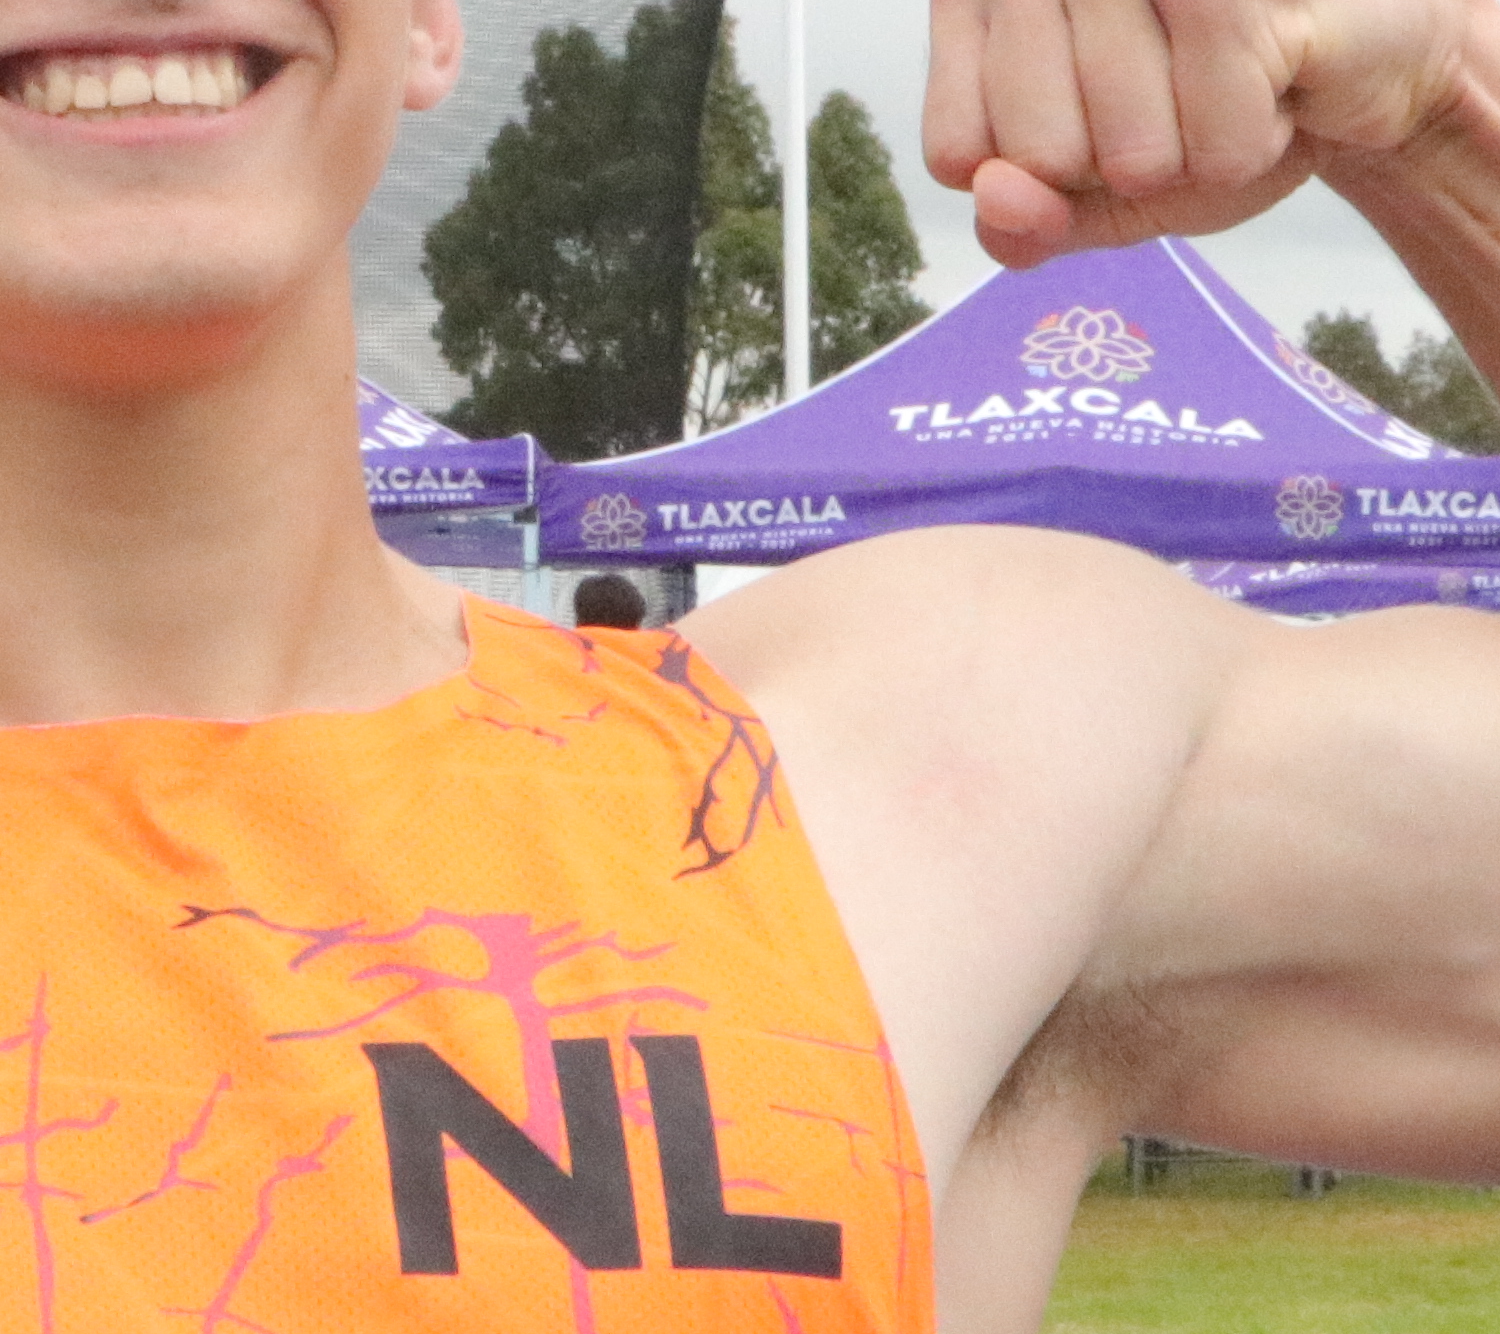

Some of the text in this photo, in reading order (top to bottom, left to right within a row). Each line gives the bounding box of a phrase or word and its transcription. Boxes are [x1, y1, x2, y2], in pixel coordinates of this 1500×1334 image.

[889, 386, 1264, 441] TLAXCALA
[915, 418, 1240, 447] UNA NUEVA HISTORIA
[657, 495, 846, 531] TLAXCALA
[1372, 522, 1404, 533] UNA
[1409, 523, 1459, 534] NUEVA
[361, 1033, 842, 1281] NL
